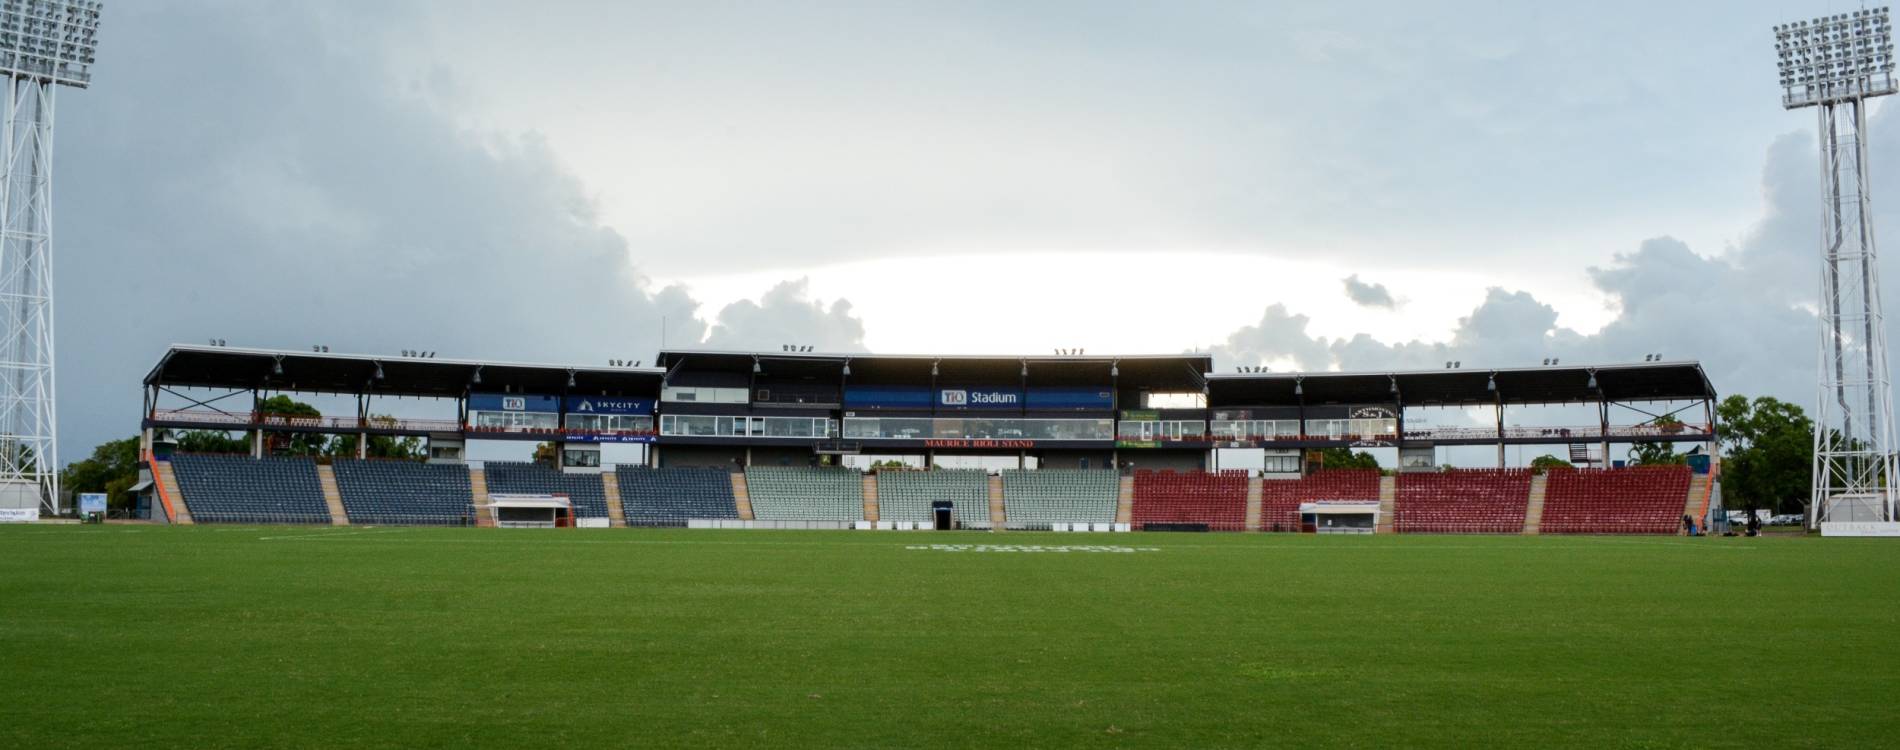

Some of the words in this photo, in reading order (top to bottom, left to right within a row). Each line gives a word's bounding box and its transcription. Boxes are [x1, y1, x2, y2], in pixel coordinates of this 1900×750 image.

[971, 391, 1017, 403] Stadium
[597, 401, 641, 409] SKYCITY
[925, 440, 969, 448] MAURICE
[973, 440, 998, 448] RIOLI
[1002, 440, 1033, 448] STAND
